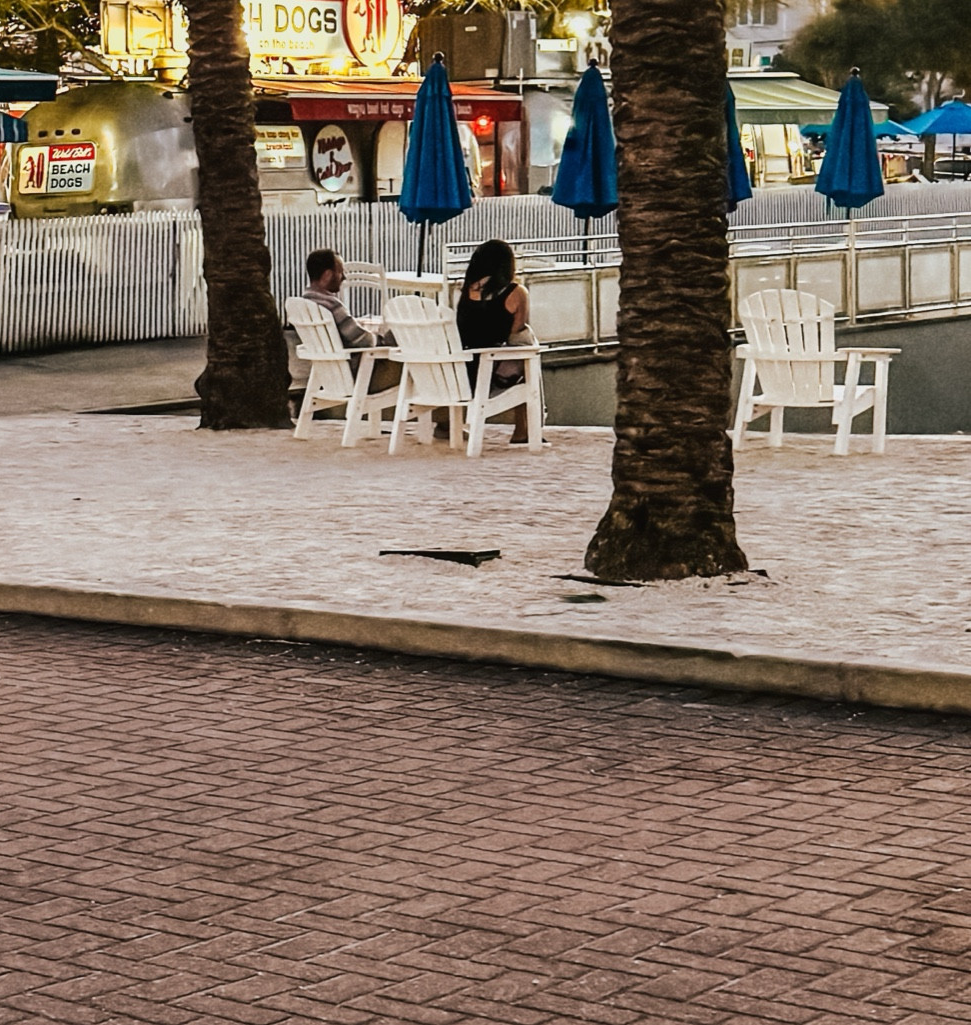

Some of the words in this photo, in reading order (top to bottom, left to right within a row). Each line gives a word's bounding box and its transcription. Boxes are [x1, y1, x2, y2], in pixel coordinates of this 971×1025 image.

[275, 4, 337, 34] DOGS
[52, 163, 91, 175] BEACH
[51, 177, 83, 189] DOGS
